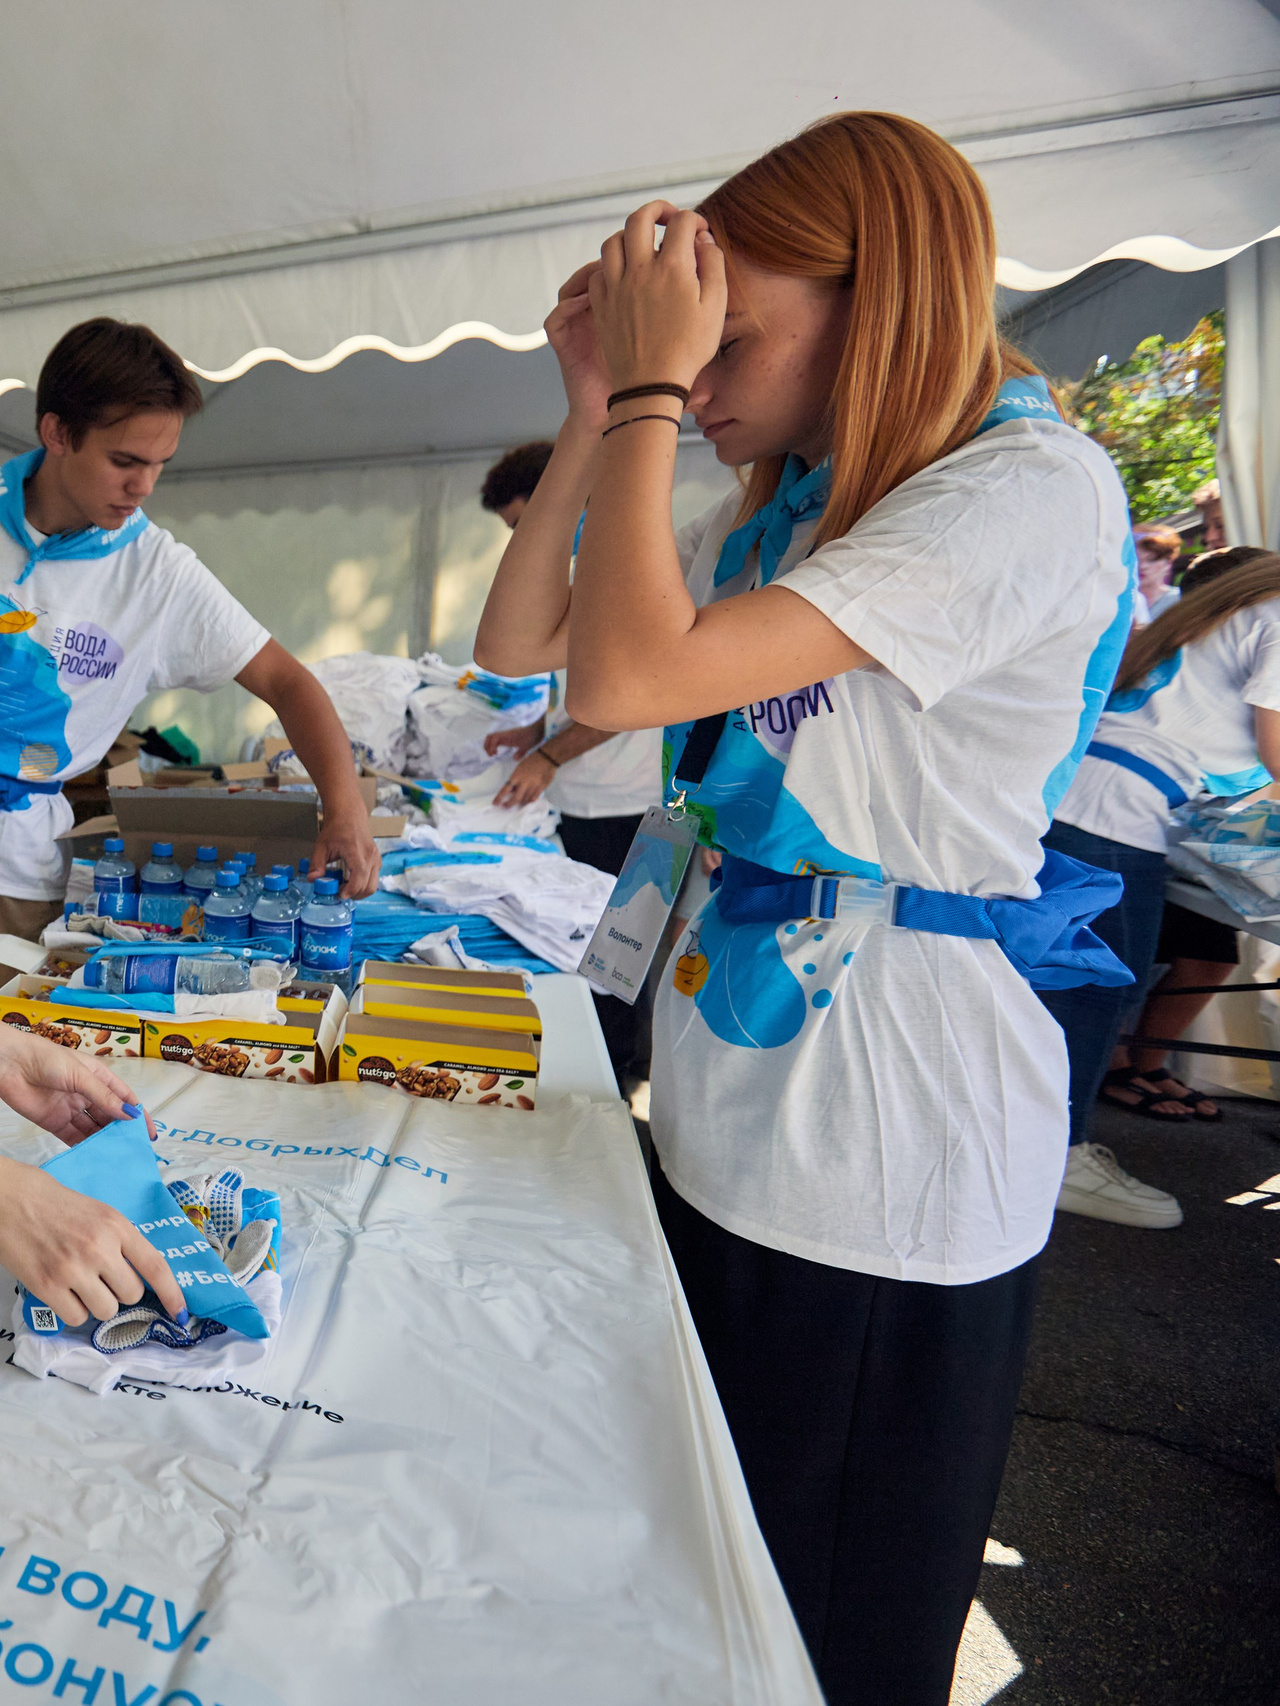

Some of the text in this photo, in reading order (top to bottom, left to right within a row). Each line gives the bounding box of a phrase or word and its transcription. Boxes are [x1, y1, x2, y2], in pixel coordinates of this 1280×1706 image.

[45, 627, 64, 669] АКЦИЯ
[65, 629, 106, 658] ВОДА
[58, 653, 117, 679] РОССИИ
[608, 926, 642, 952] Волонтер
[160, 1044, 194, 1056] nut&go
[358, 1066, 396, 1080] nut&go
[153, 1119, 448, 1184] егДобрыхДел
[176, 1270, 241, 1288] #Бер
[17, 1555, 210, 1653] воду,
